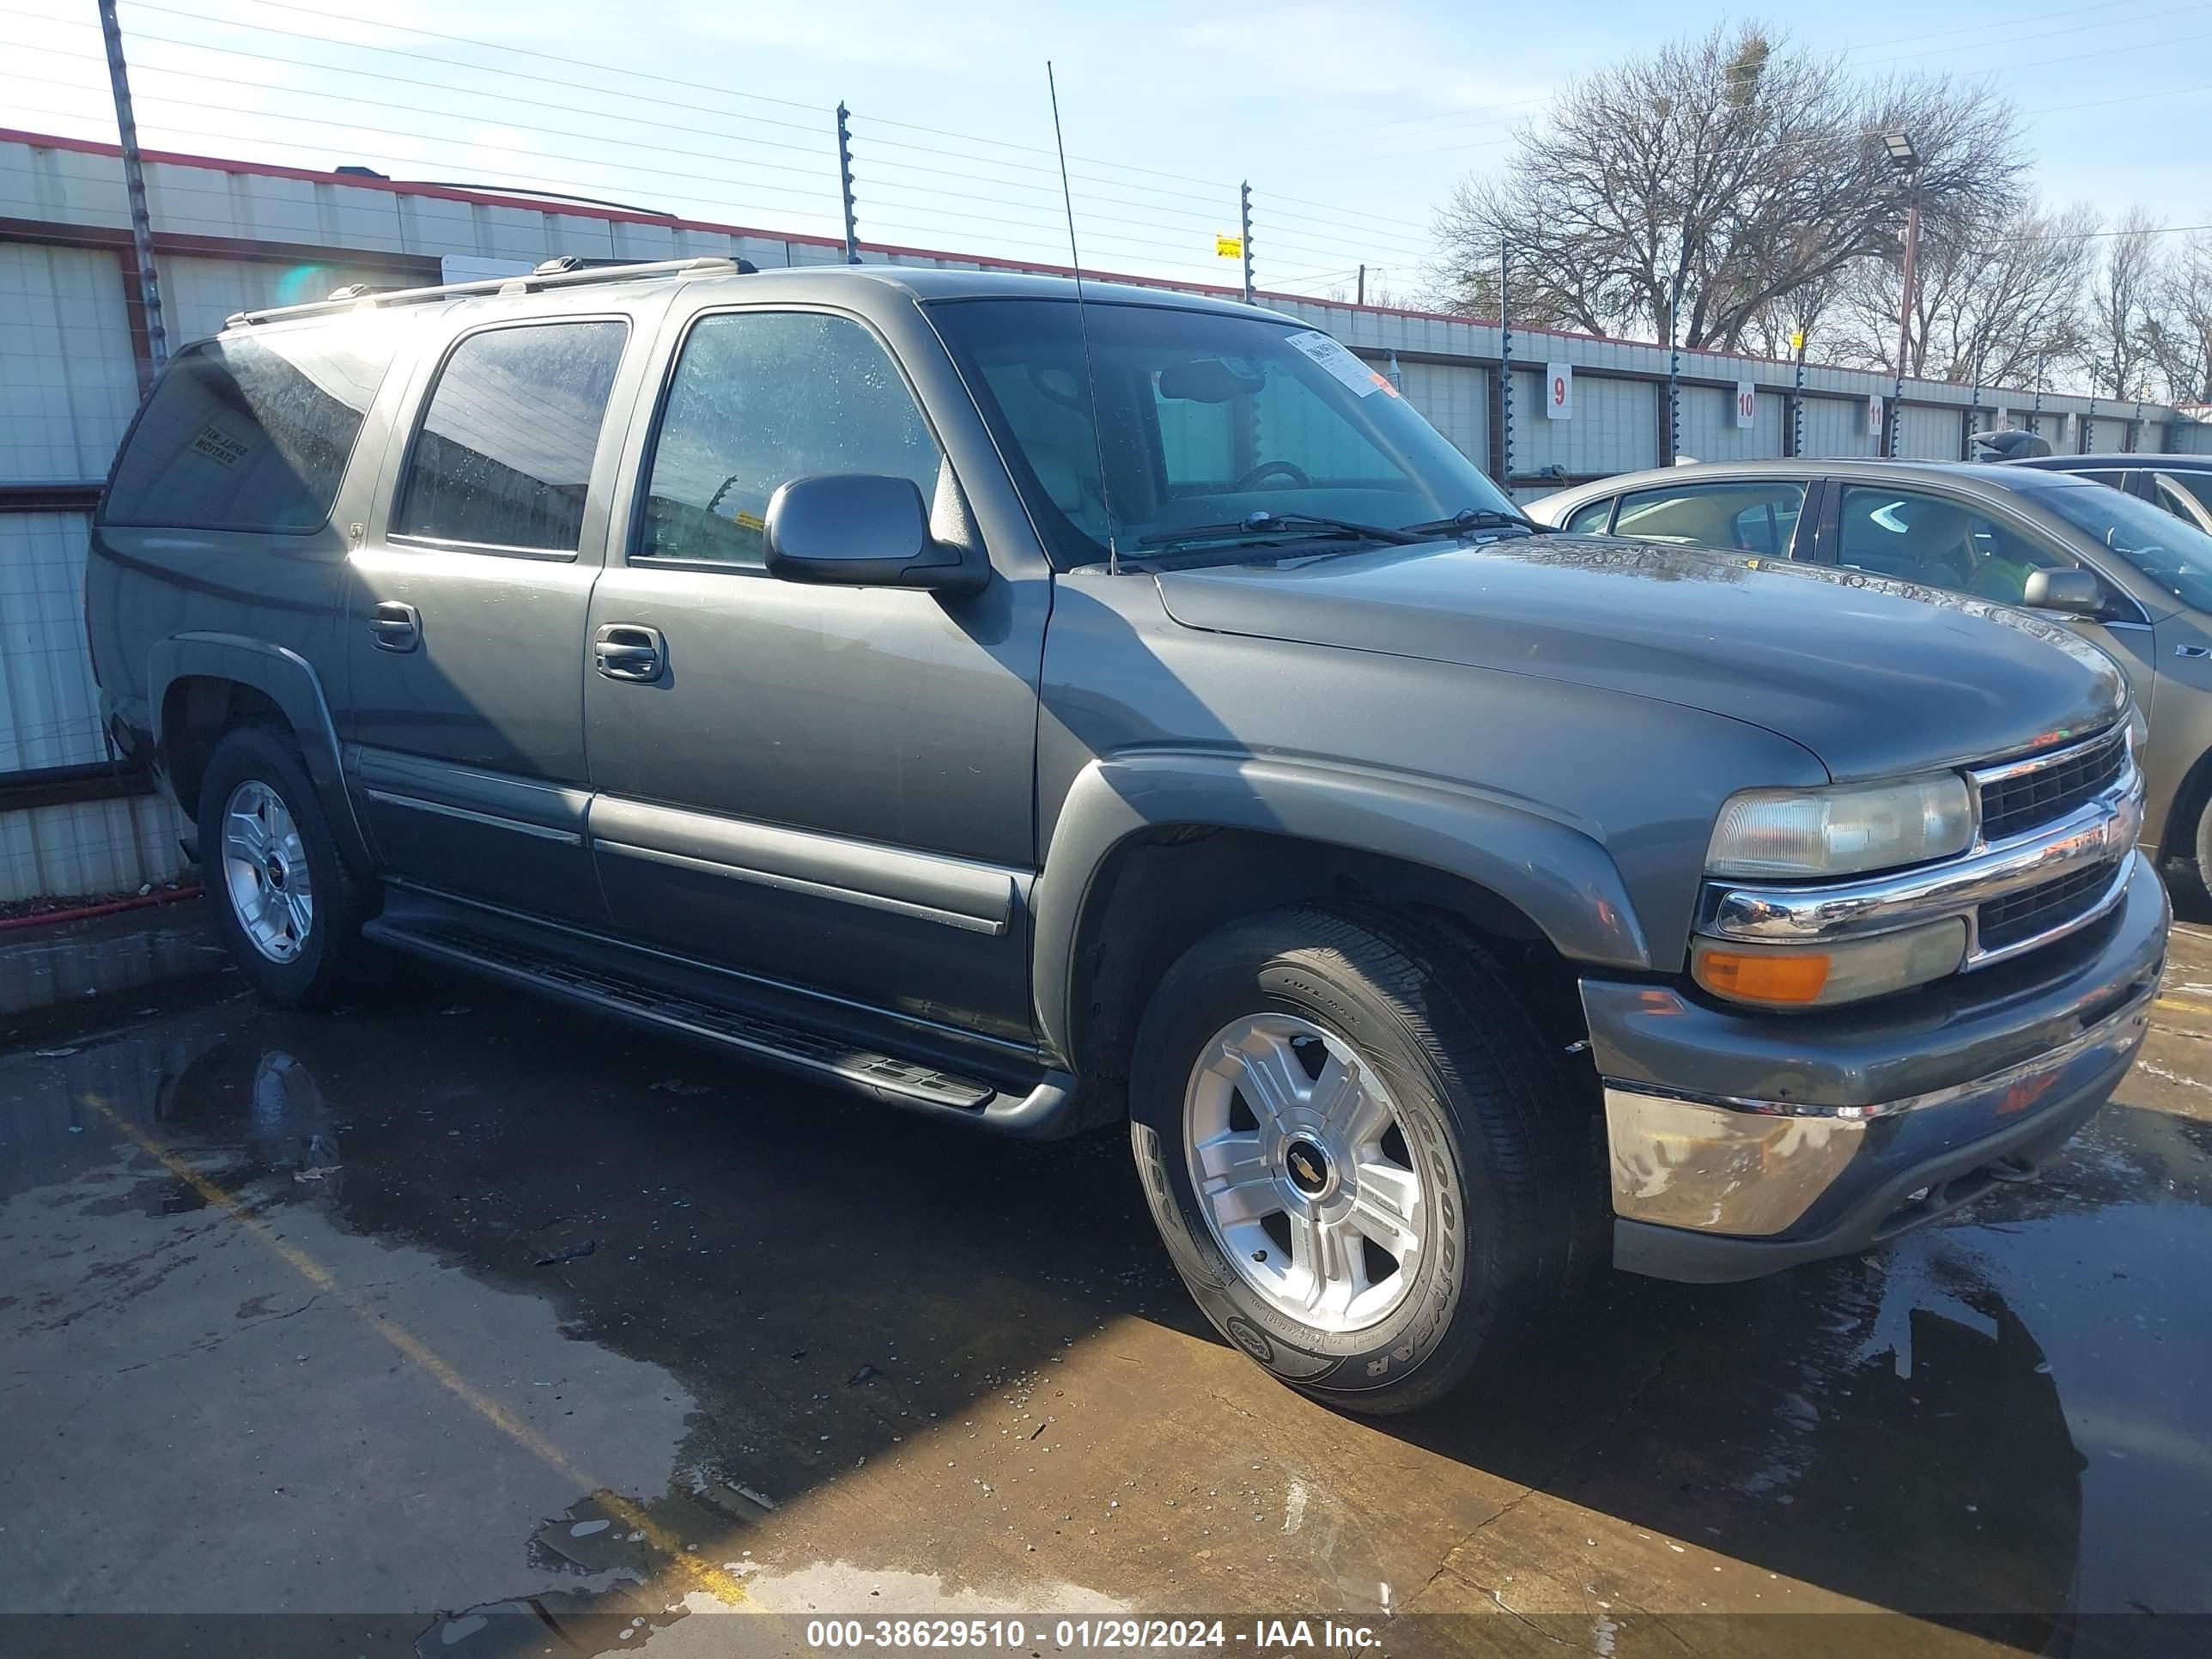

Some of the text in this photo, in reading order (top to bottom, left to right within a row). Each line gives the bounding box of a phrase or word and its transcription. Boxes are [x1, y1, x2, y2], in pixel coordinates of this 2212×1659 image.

[1554, 376, 1565, 405] 9
[1738, 393, 1753, 417] 10
[1869, 404, 1882, 426] 11
[1284, 977, 1324, 1001] FUEL
[1327, 999, 1361, 1026] MAX
[1366, 1108, 1454, 1376] GOODYEAR
